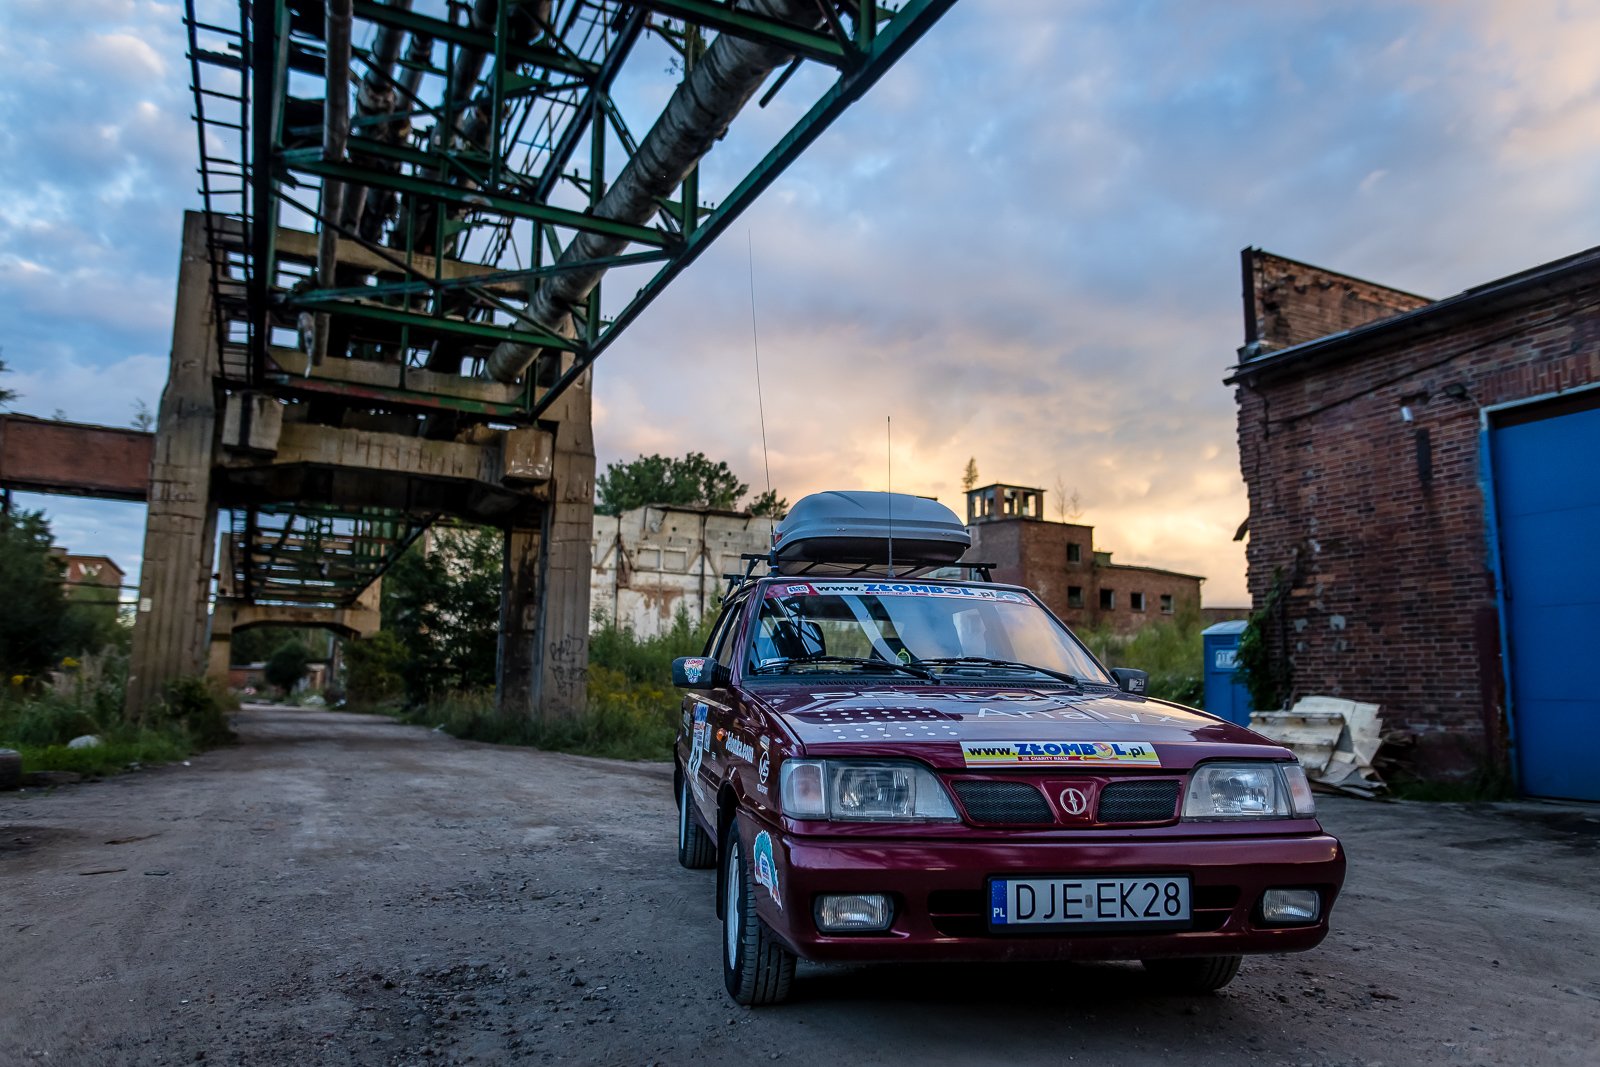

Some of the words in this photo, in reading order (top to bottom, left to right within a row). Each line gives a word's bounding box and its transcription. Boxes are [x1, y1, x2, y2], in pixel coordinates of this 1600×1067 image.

[968, 743, 1146, 759] www.ZŁOMBOL.pl
[1016, 883, 1083, 920] DJE
[1097, 882, 1181, 918] EK28
[993, 907, 1006, 917] PL
